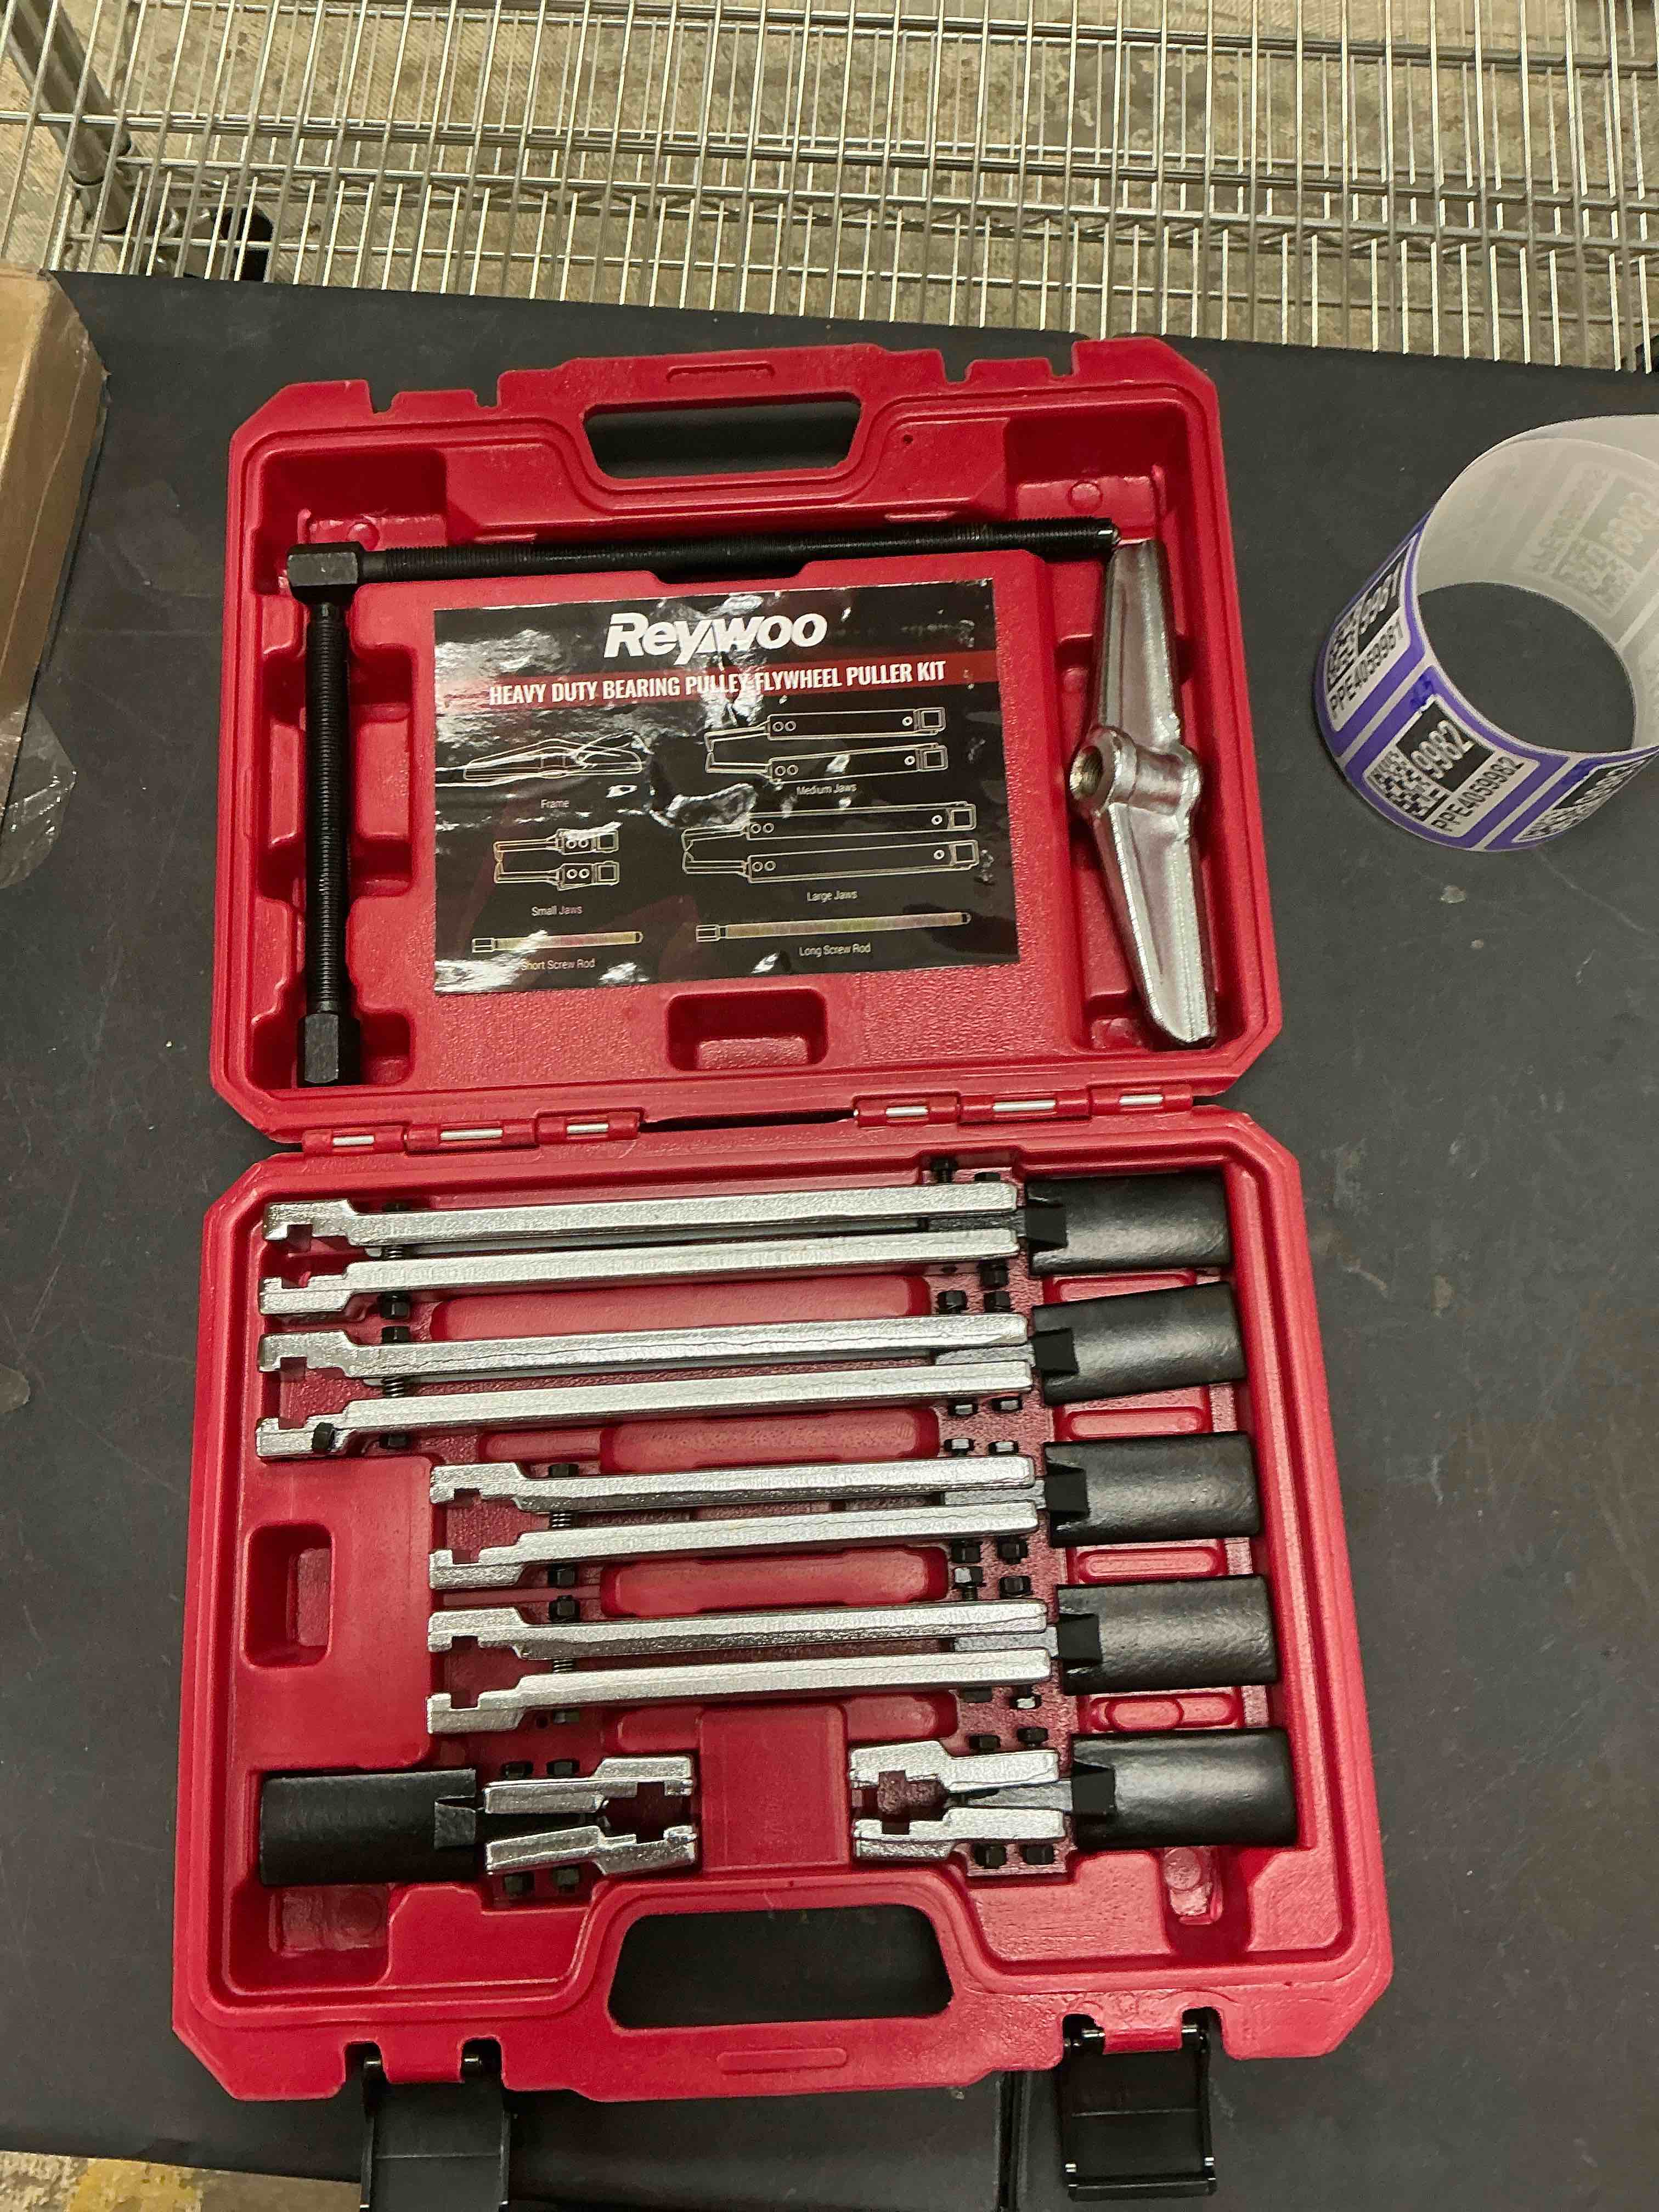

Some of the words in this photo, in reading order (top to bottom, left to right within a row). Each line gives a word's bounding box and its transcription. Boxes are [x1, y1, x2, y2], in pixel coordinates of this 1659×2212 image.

[603, 612, 828, 665] Reywoo
[489, 684, 546, 706] HEAVY
[551, 680, 599, 703] DUTY
[602, 676, 681, 700] BEARING
[846, 663, 912, 686] PULLER
[917, 661, 946, 682] KIT
[1410, 720, 1477, 780] 9982
[1431, 756, 1525, 832] PPE4059982
[540, 799, 571, 809] Frame
[806, 892, 833, 903] Large
[833, 890, 858, 900] Jaws
[531, 905, 557, 917] Small
[558, 905, 583, 915] Jaws
[799, 946, 822, 958] Long
[823, 944, 851, 955] Screw
[852, 942, 871, 953] Rod
[547, 960, 575, 970] Screw
[576, 958, 596, 969] Rod
